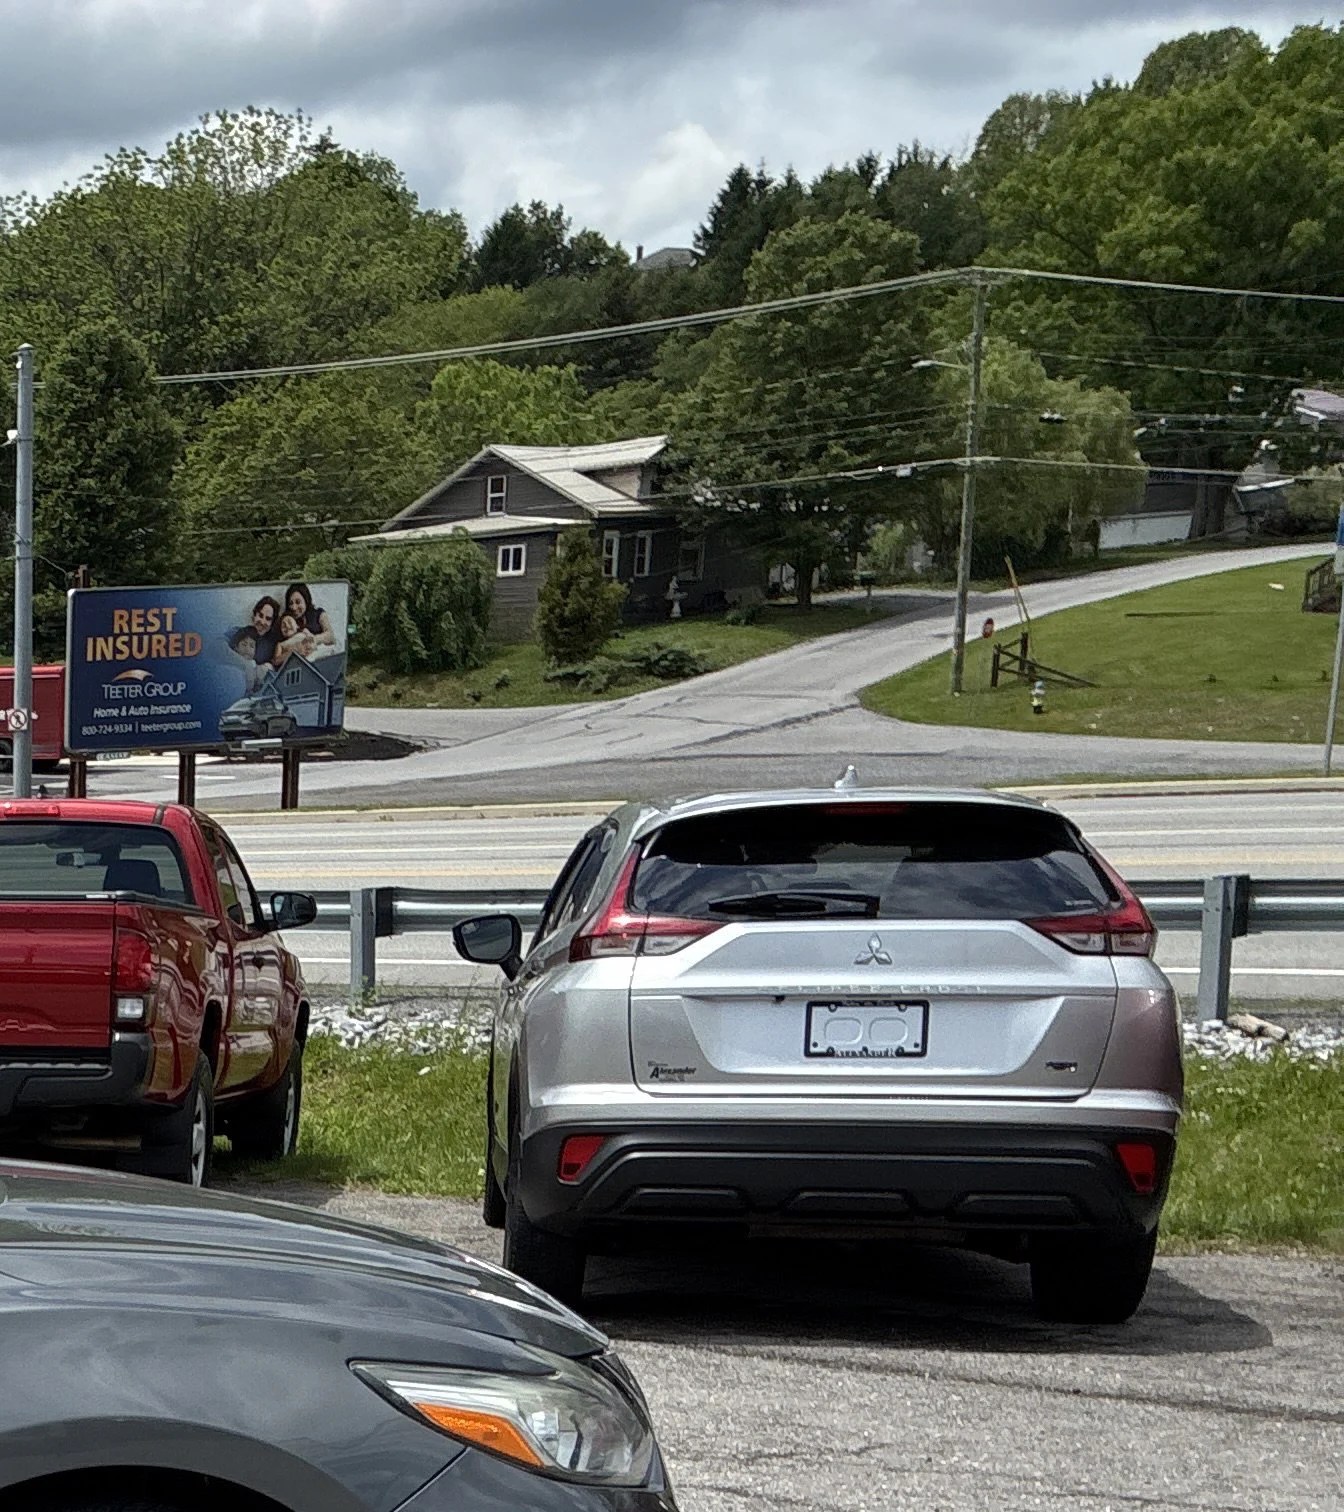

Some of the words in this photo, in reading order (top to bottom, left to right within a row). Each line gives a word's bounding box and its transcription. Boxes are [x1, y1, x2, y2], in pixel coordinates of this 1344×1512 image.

[113, 607, 177, 634] REST
[86, 632, 203, 662] INSURED
[102, 684, 144, 700] TEETER
[144, 681, 186, 697] GROUP
[93, 706, 120, 719] Home
[128, 704, 149, 716] Auto
[149, 703, 192, 716] Insurance
